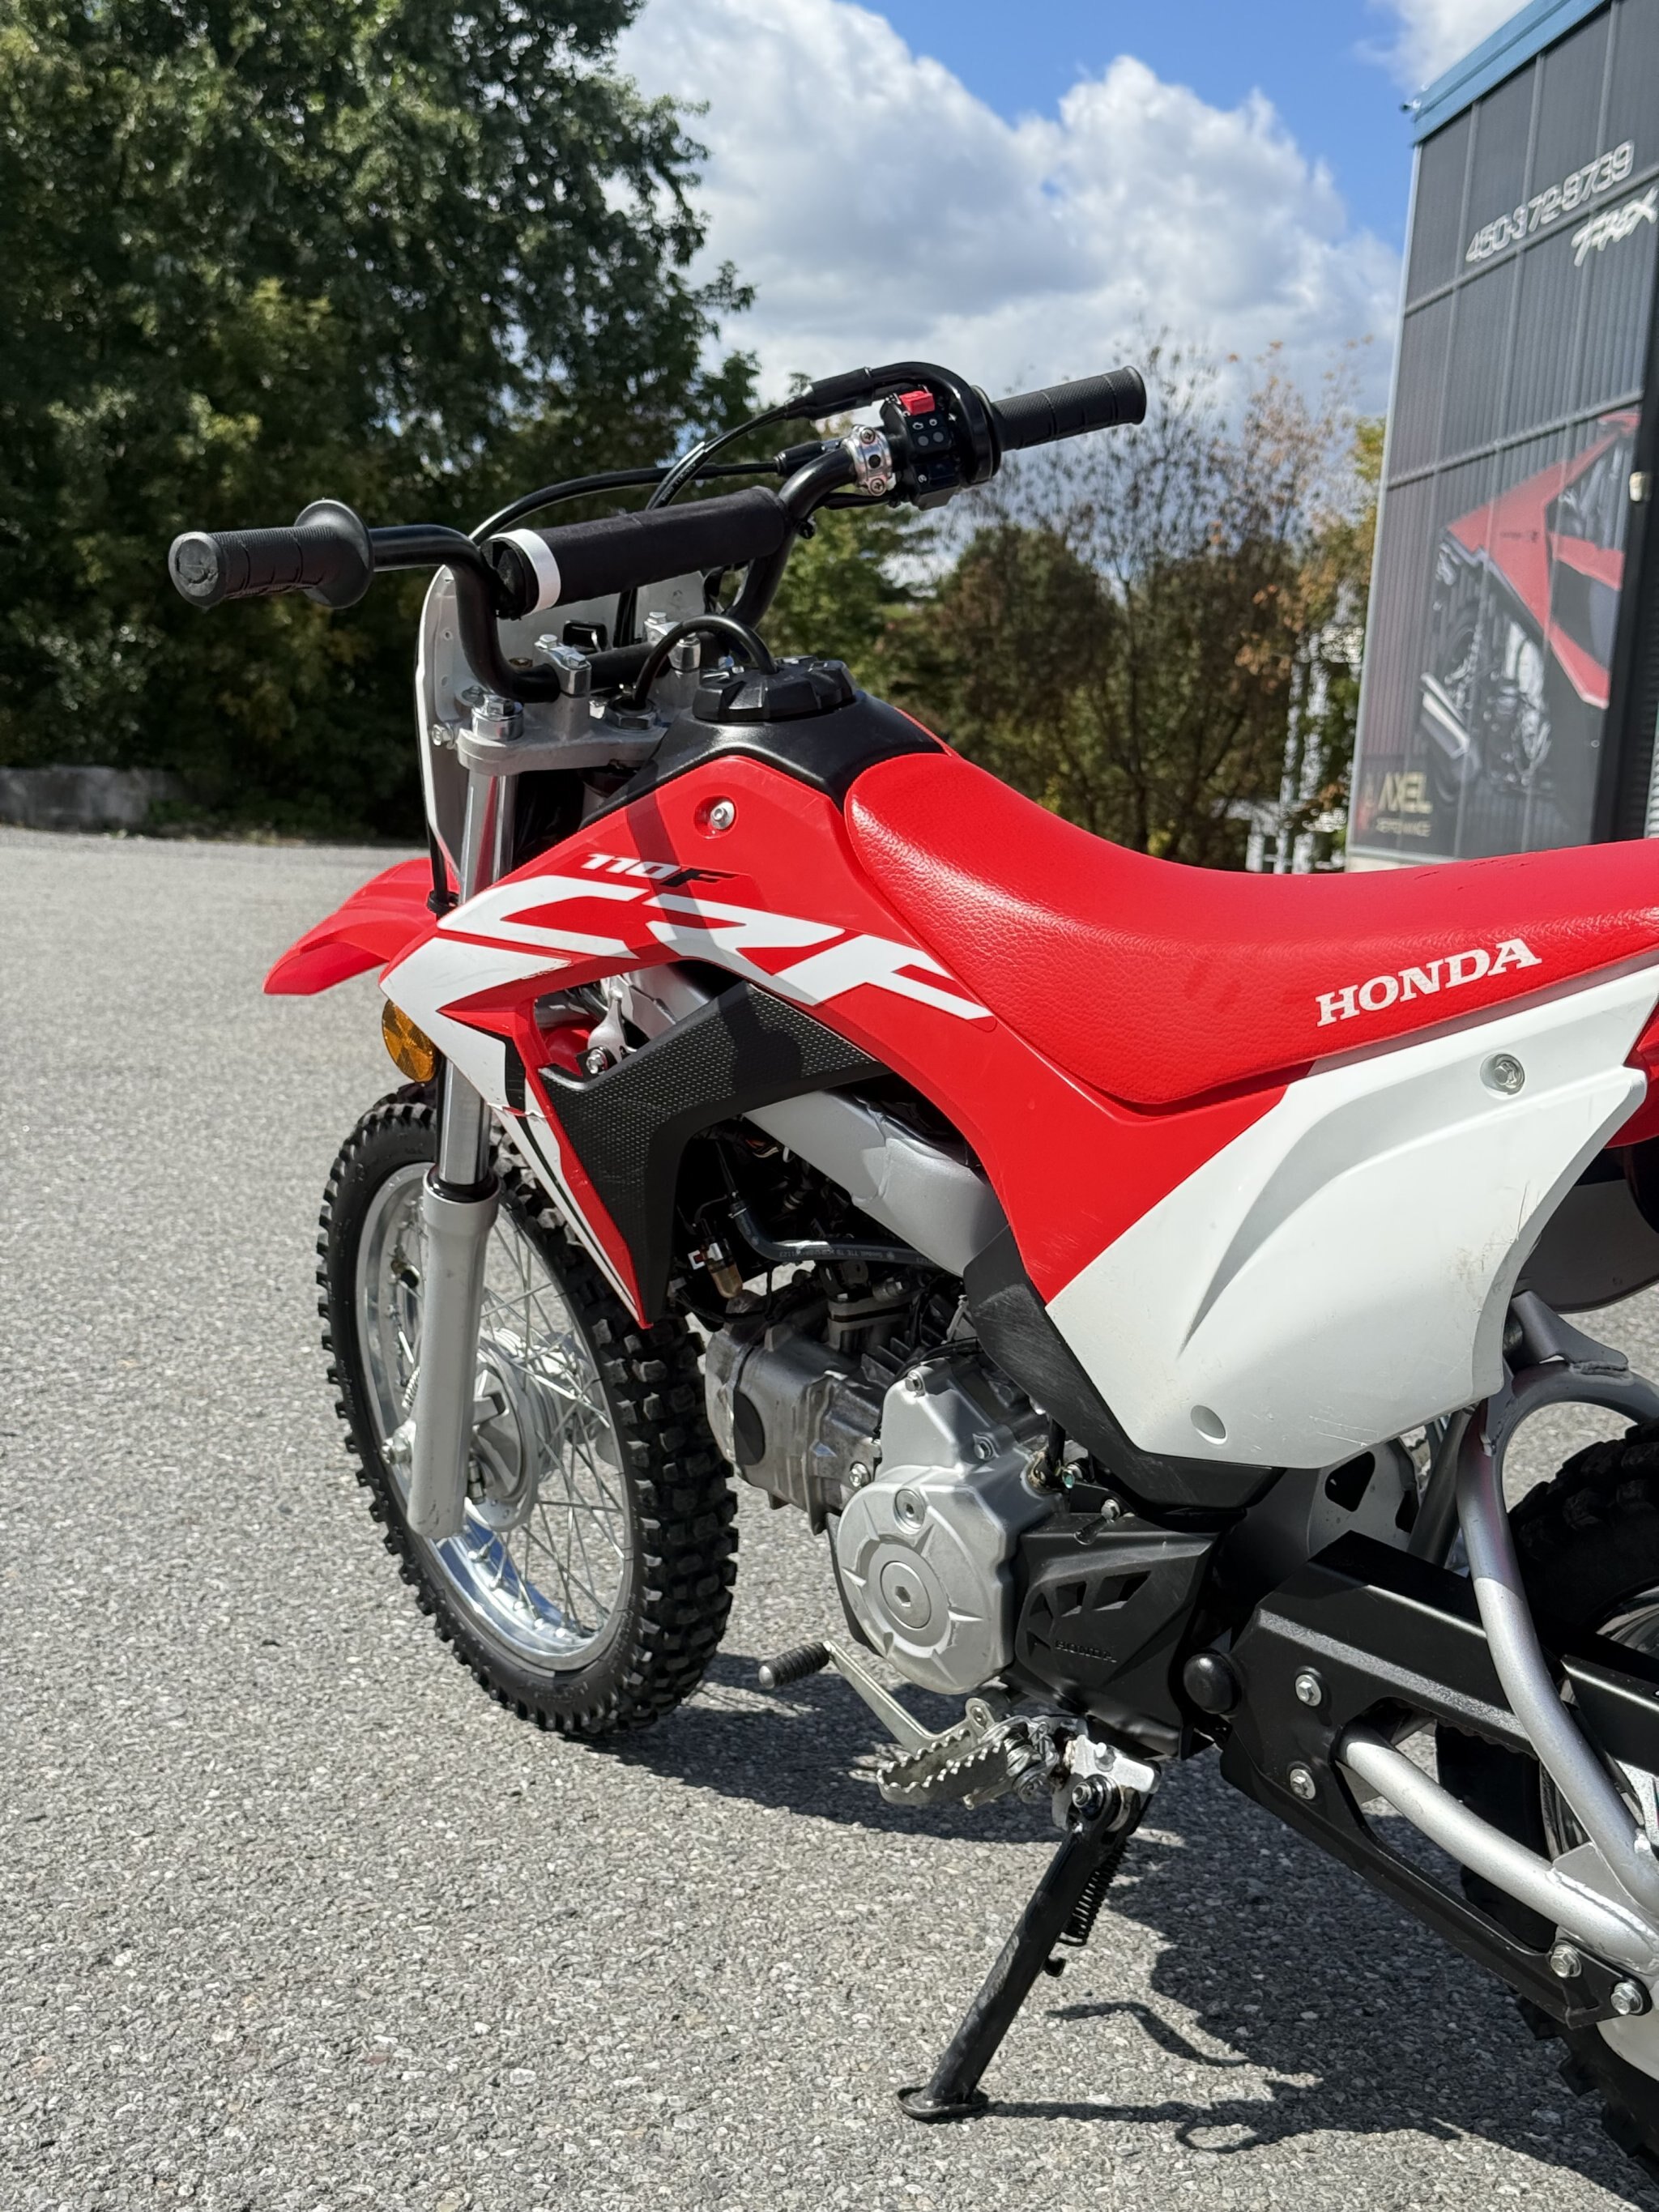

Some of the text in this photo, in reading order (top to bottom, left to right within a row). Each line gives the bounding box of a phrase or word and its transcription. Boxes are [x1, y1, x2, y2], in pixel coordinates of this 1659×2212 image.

[1378, 771, 1432, 813] AXEL
[580, 853, 737, 888] 110F
[1316, 938, 1542, 1027] HONDA
